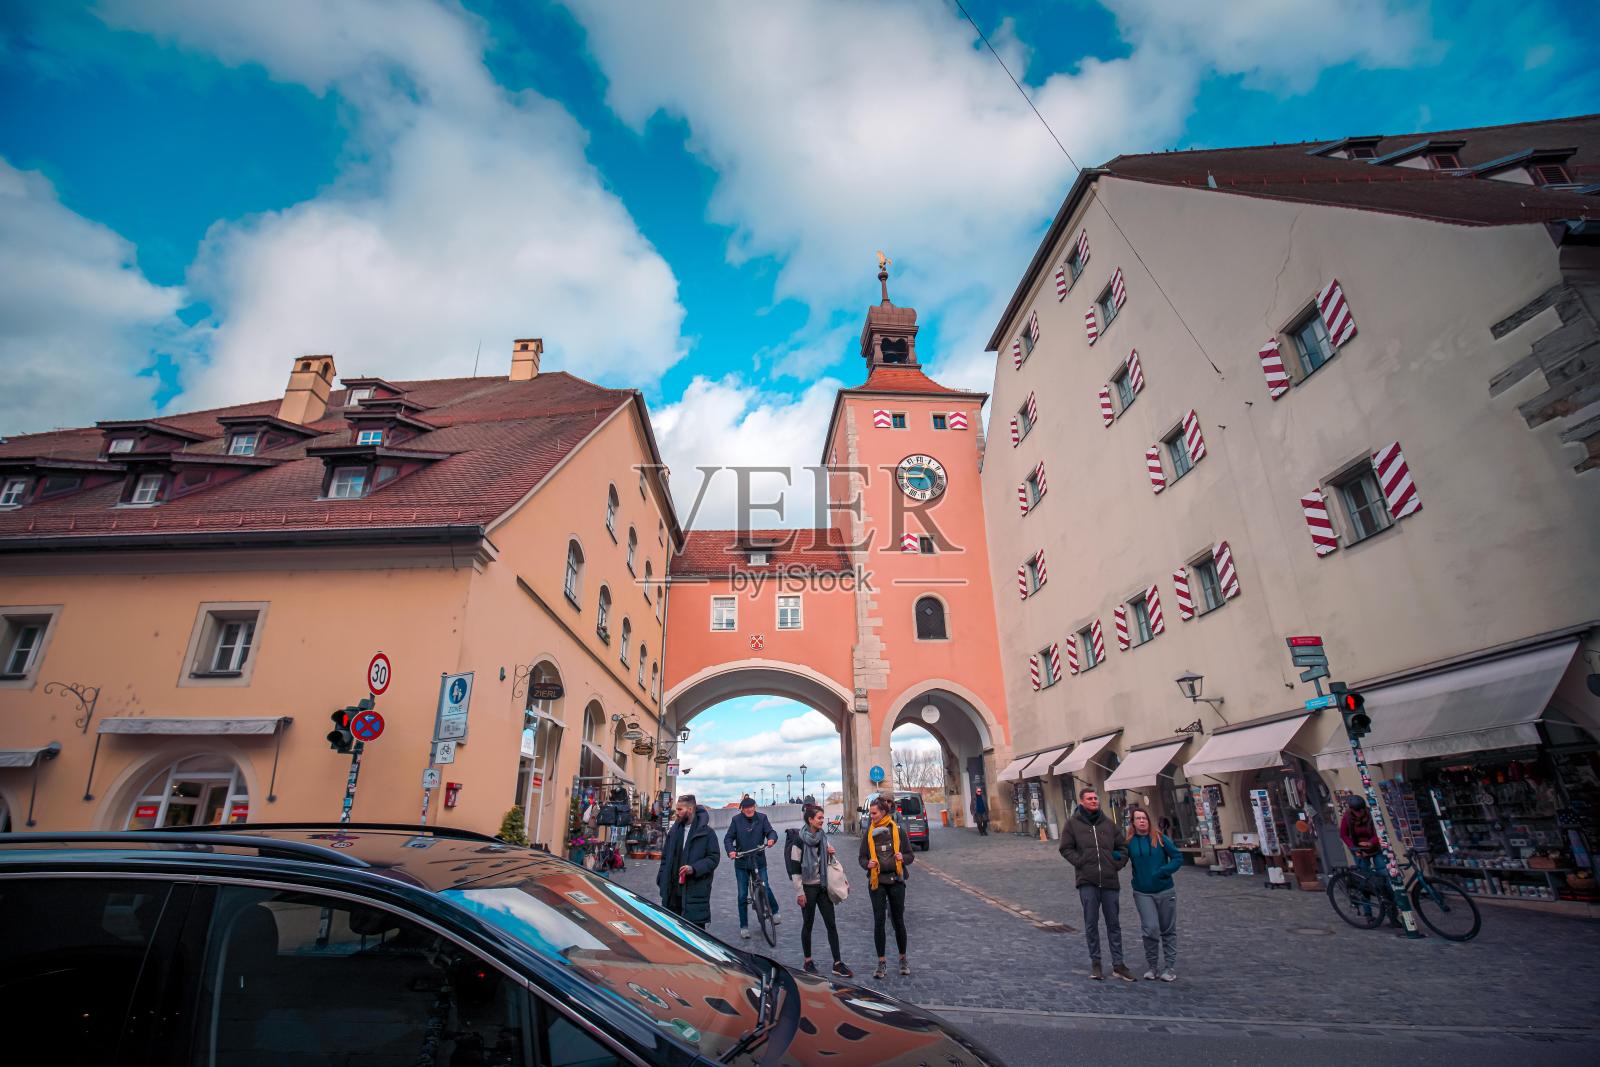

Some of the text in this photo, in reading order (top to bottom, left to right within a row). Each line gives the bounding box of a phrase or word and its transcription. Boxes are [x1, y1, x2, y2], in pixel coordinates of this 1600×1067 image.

[372, 663, 386, 684] 30
[534, 689, 557, 698] ZIERL
[448, 704, 463, 713] ZONE
